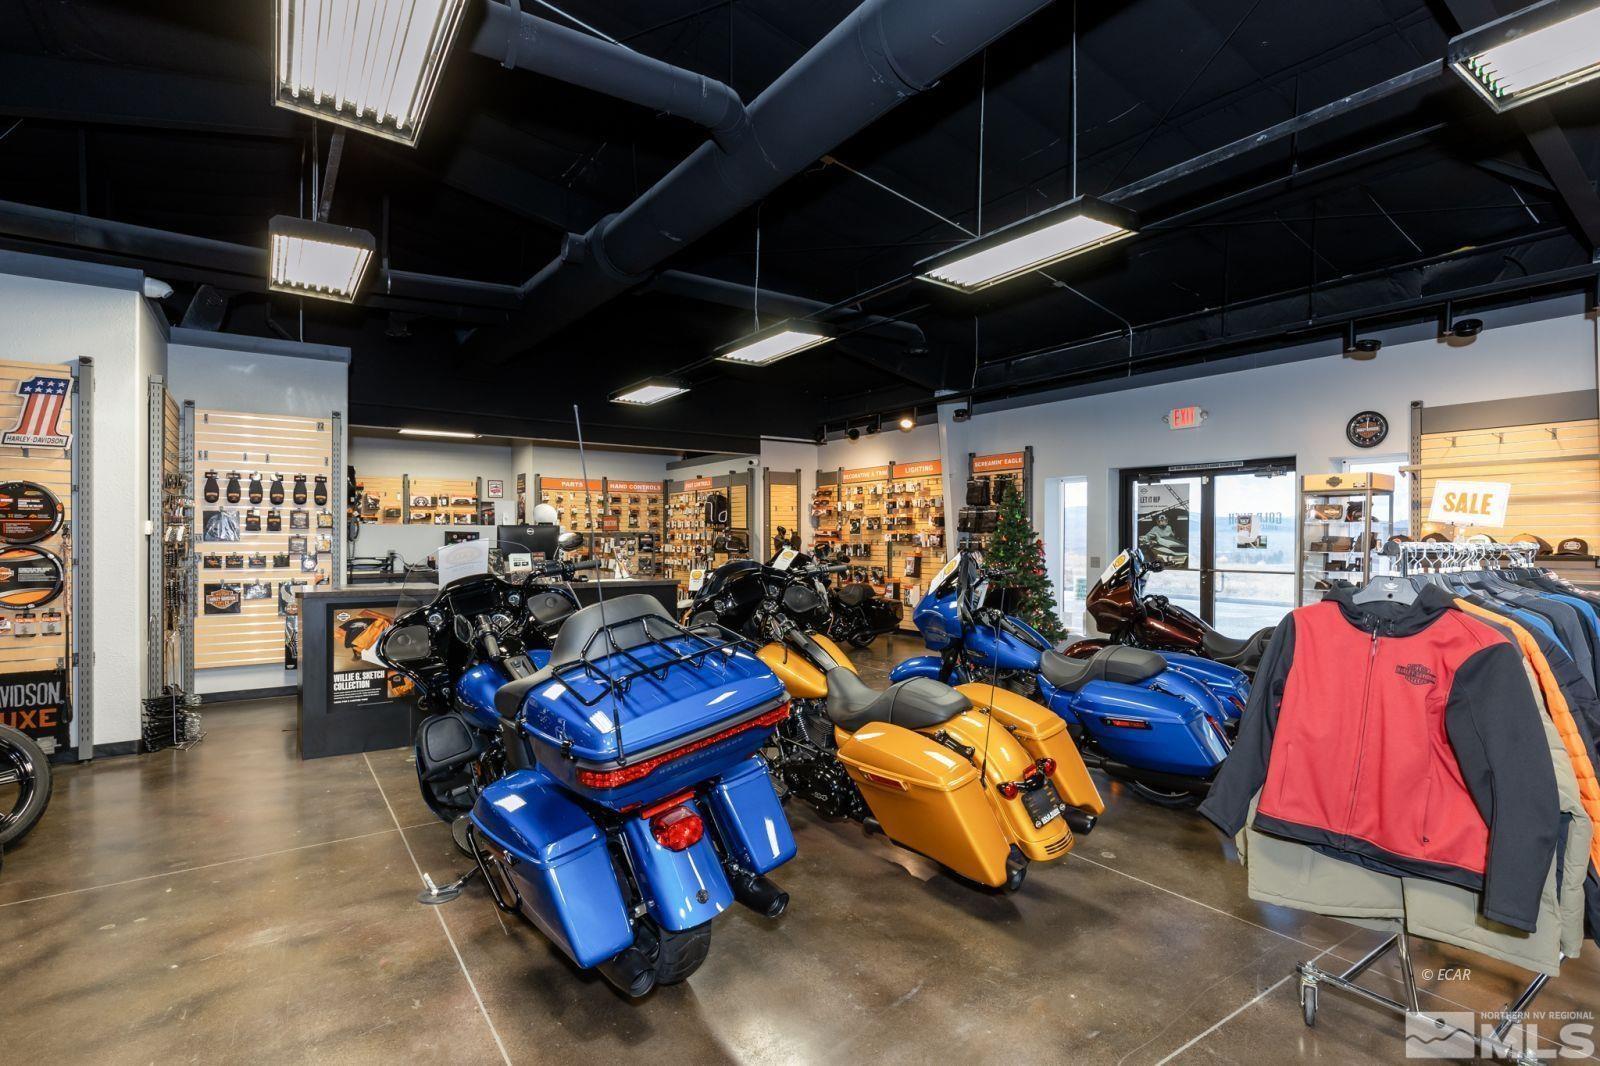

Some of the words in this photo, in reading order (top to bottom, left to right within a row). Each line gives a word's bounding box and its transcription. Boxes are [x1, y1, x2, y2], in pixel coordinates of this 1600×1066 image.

[1174, 407, 1195, 427] EXIT
[6, 434, 65, 445] HARLEY-DAVIDSON
[904, 464, 934, 474] LIGHTING
[1443, 491, 1494, 515] SALE
[333, 672, 355, 683] WILLIE
[362, 670, 385, 680] SKETCH
[333, 680, 370, 691] COLLECTION
[0, 681, 62, 708] VIDSON
